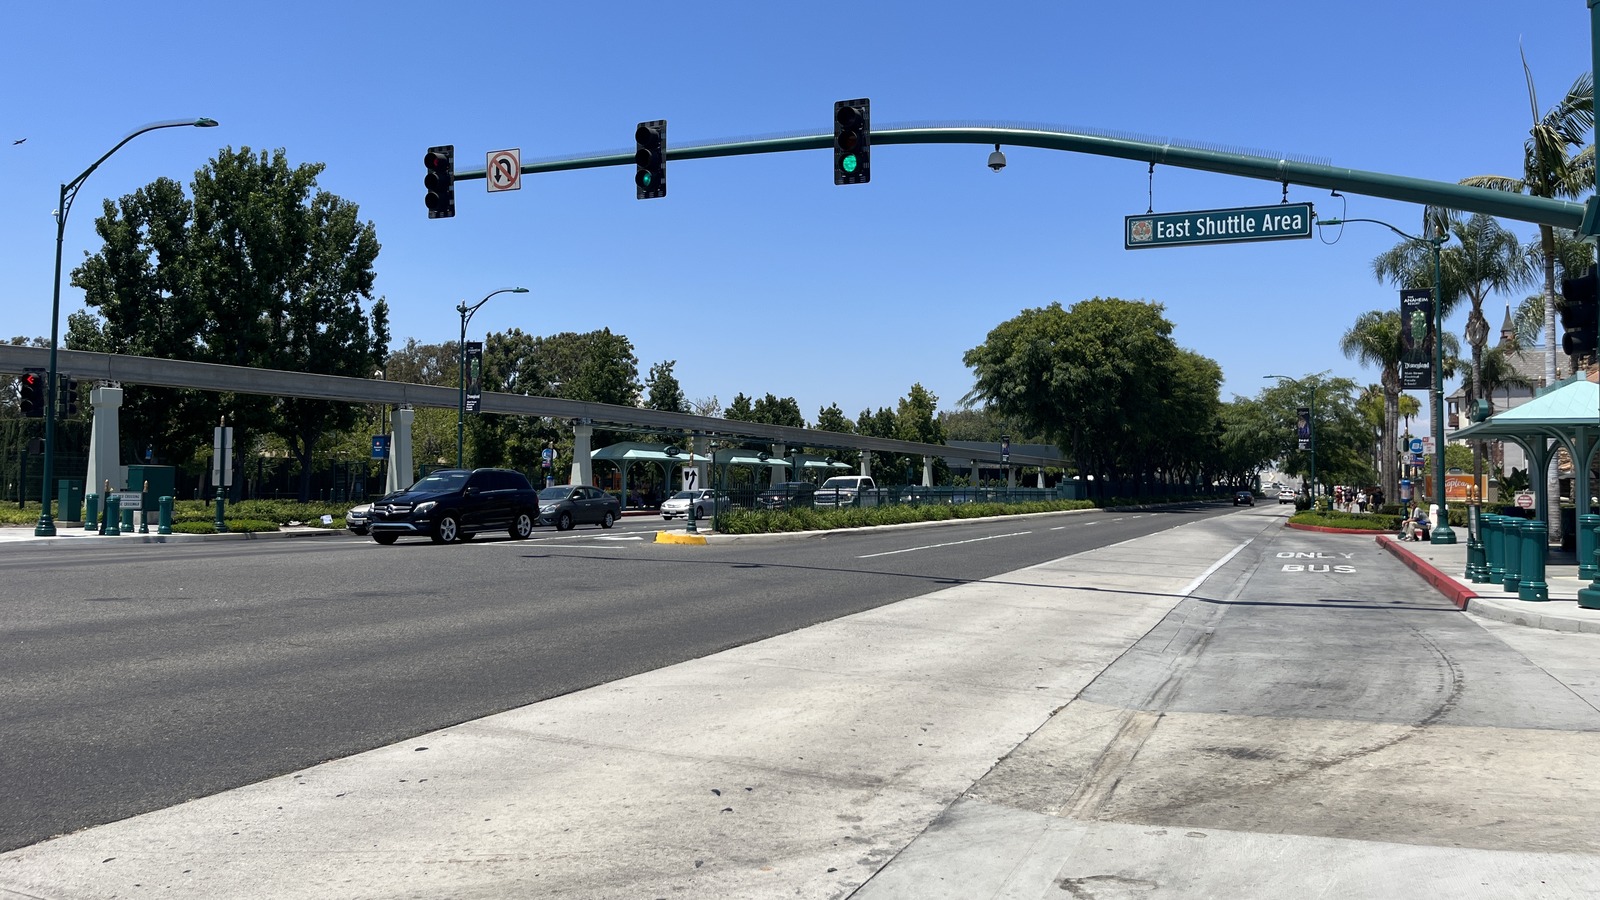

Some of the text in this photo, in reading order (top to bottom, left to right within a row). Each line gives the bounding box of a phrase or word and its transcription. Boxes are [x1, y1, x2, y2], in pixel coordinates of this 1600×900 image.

[1157, 214, 1302, 238] East Shuttle Area
[1281, 564, 1356, 573] BUS
